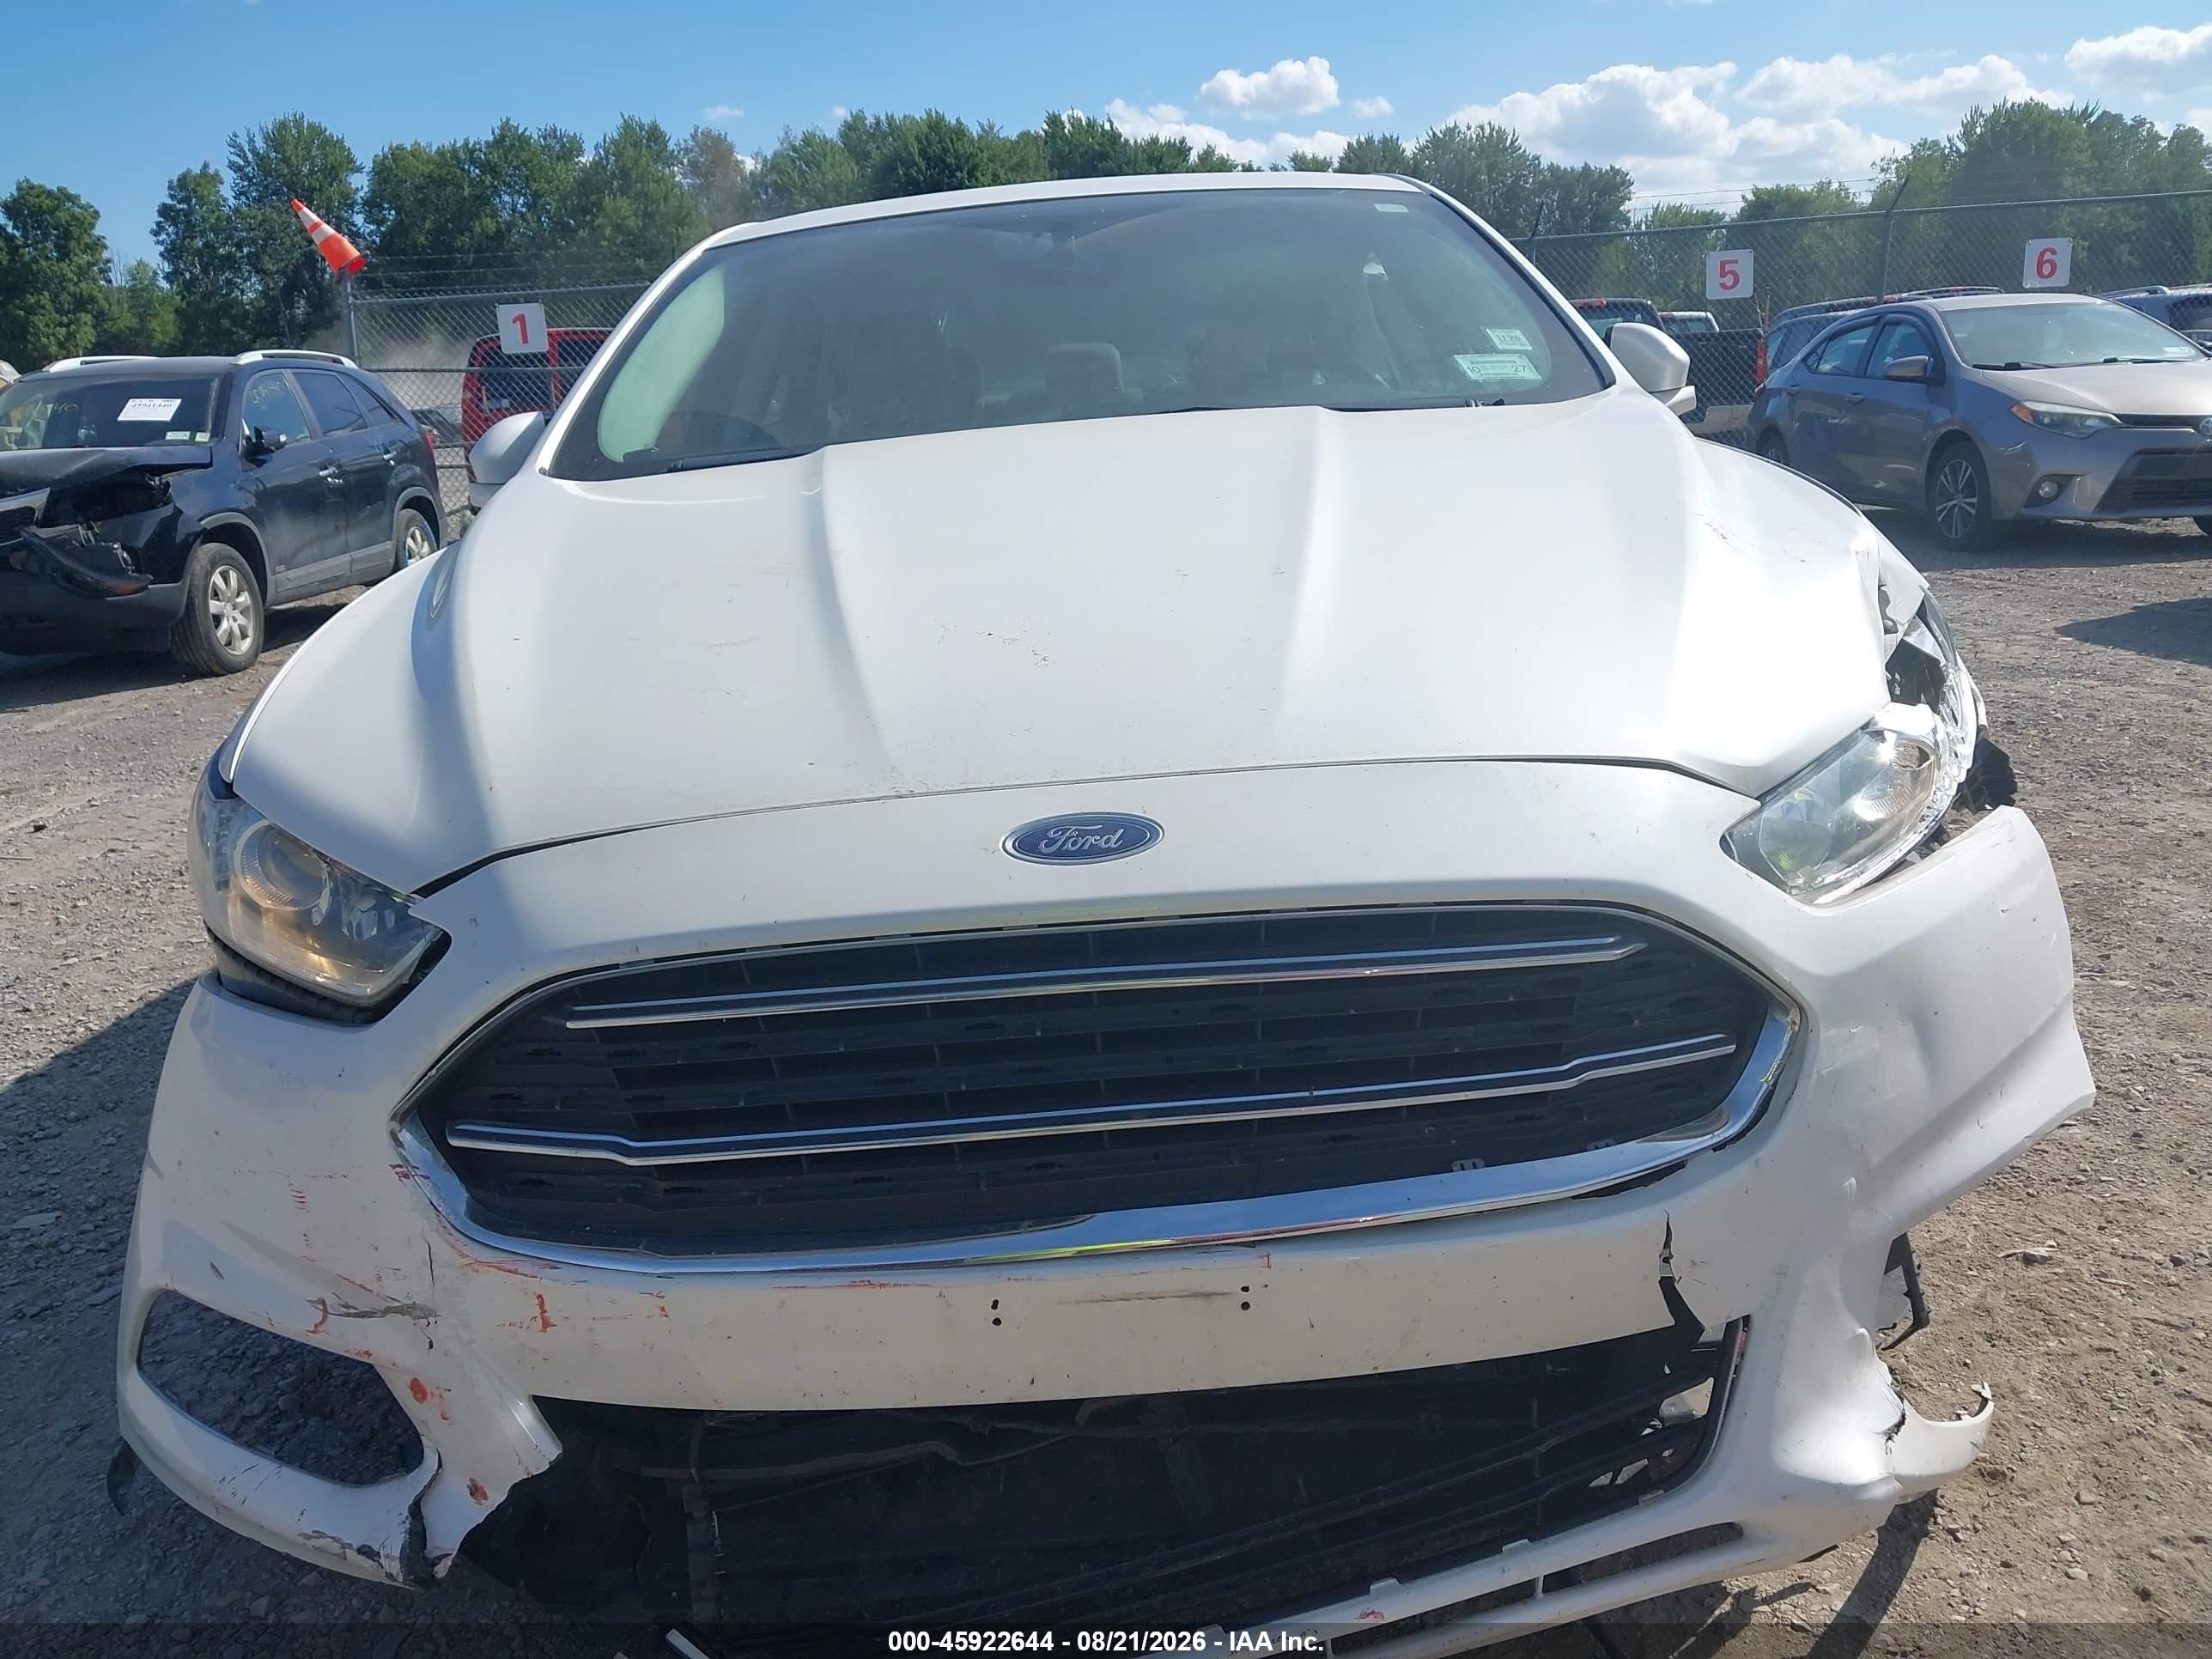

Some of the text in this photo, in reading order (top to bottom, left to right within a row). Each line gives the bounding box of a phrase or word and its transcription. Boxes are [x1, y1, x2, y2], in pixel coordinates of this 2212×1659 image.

[1719, 259, 1740, 290] 5
[2037, 247, 2058, 279] 6
[512, 313, 529, 344] 1
[1038, 824, 1125, 854] Ford
